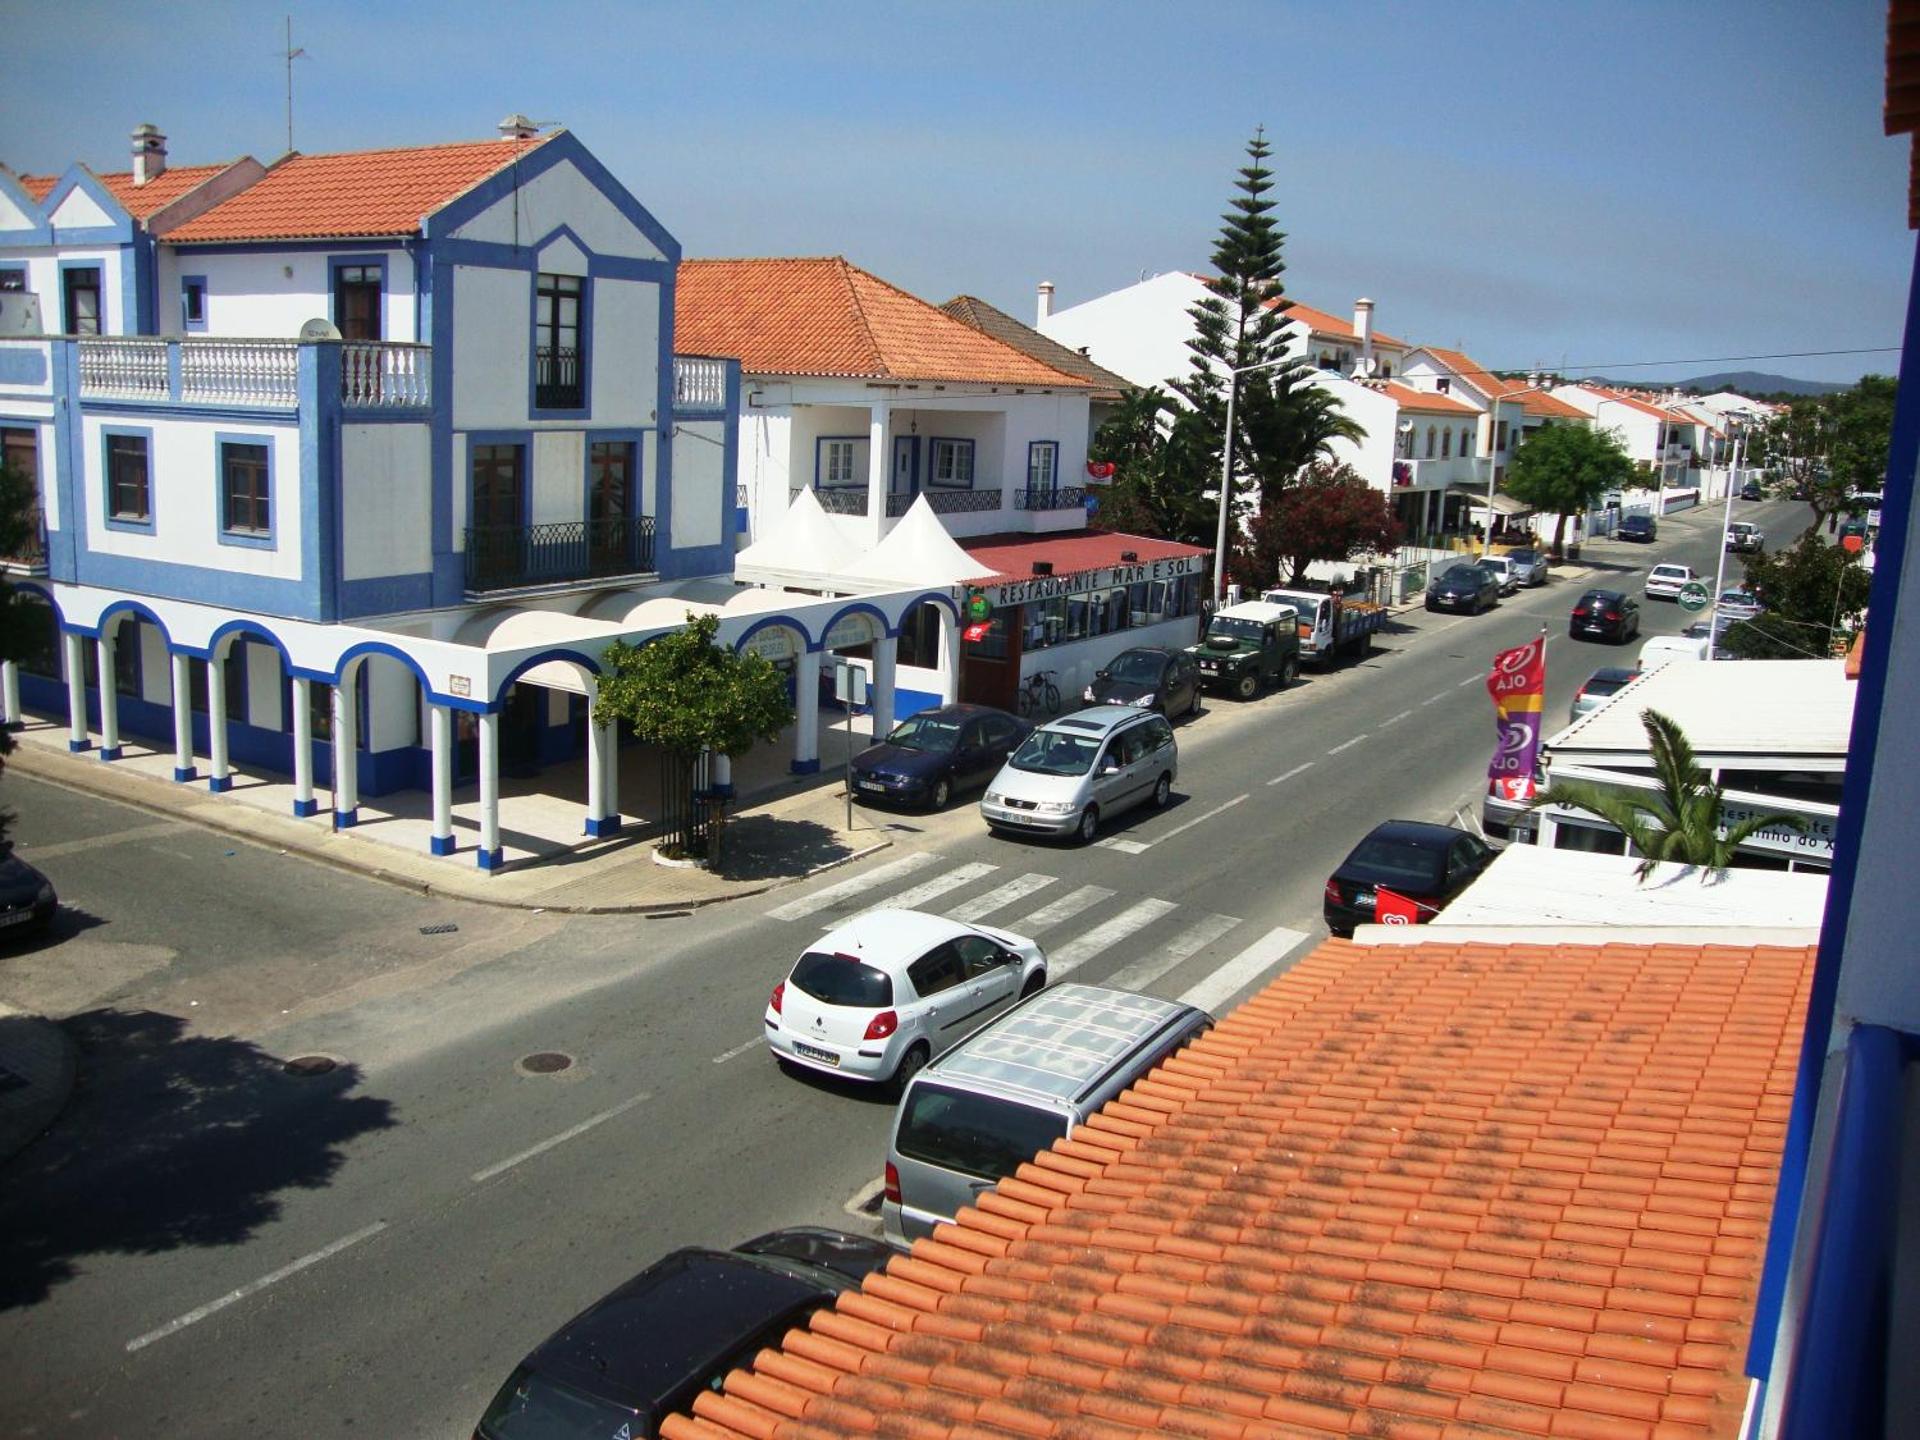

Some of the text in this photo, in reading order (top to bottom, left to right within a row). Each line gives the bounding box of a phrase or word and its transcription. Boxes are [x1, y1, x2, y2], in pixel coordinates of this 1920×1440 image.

[1000, 558, 1192, 604] RESTAURANTE MAR E SOL
